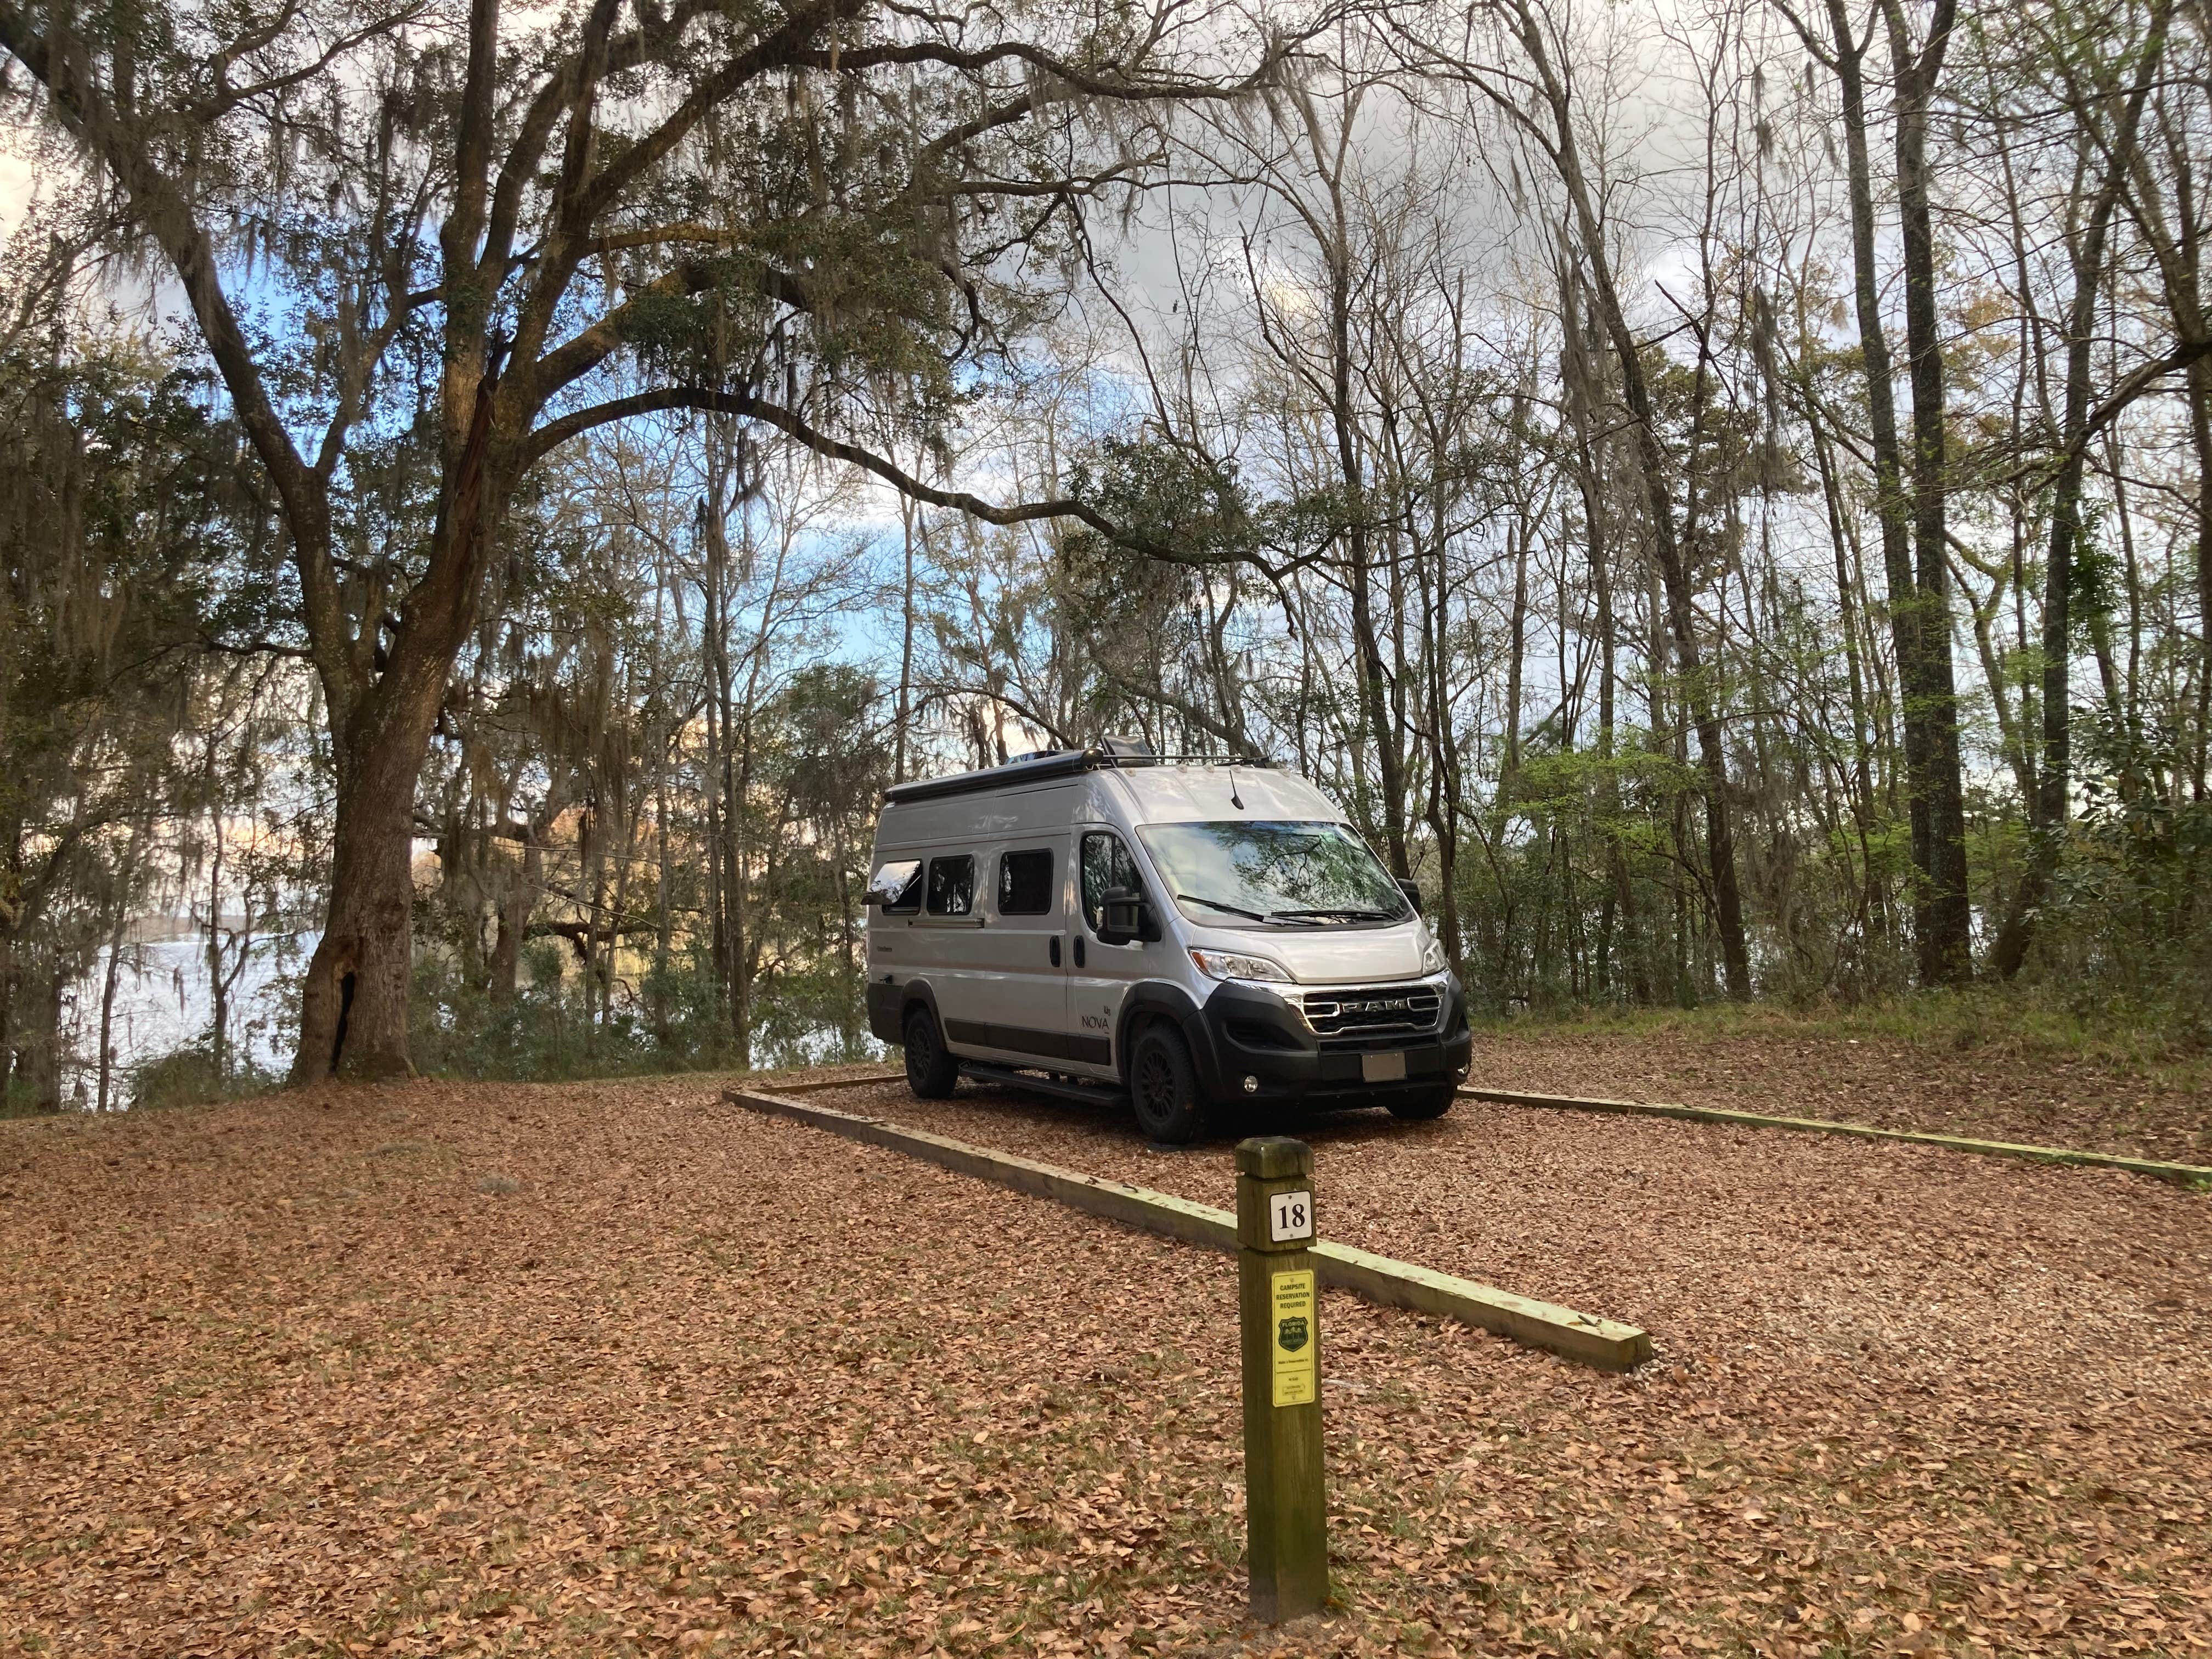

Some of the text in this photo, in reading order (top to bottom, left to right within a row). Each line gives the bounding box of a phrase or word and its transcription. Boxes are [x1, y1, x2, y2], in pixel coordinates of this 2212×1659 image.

[1342, 1000, 1404, 1013] RAM
[1082, 1015, 1109, 1029] NOVA
[1278, 1204, 1305, 1229] 18
[1276, 1292, 1310, 1300] RESERVATION
[1280, 1301, 1306, 1309] REQUIRED
